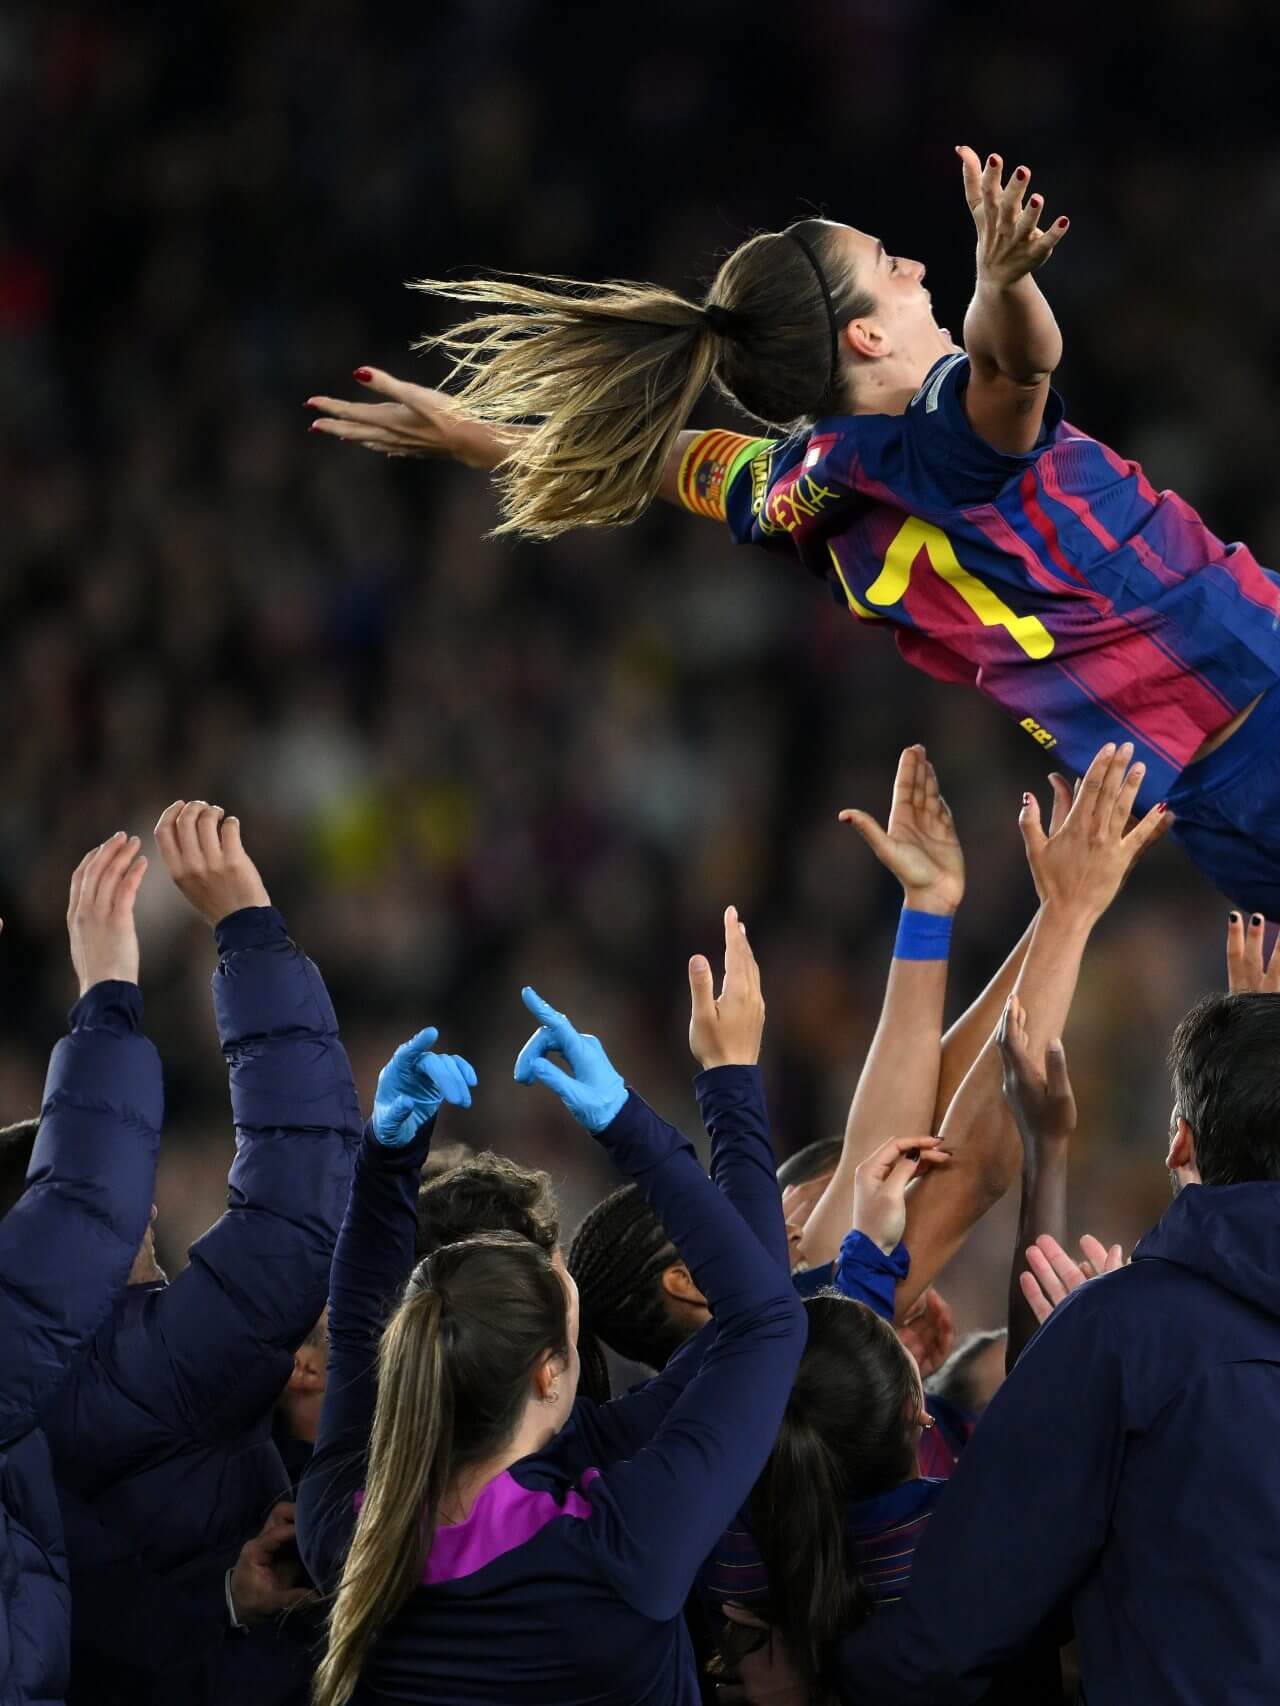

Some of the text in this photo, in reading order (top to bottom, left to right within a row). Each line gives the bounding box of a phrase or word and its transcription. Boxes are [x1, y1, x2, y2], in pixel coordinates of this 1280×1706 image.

[754, 454, 769, 513] IMBO
[760, 474, 840, 536] EXIA
[828, 515, 1055, 660] 1
